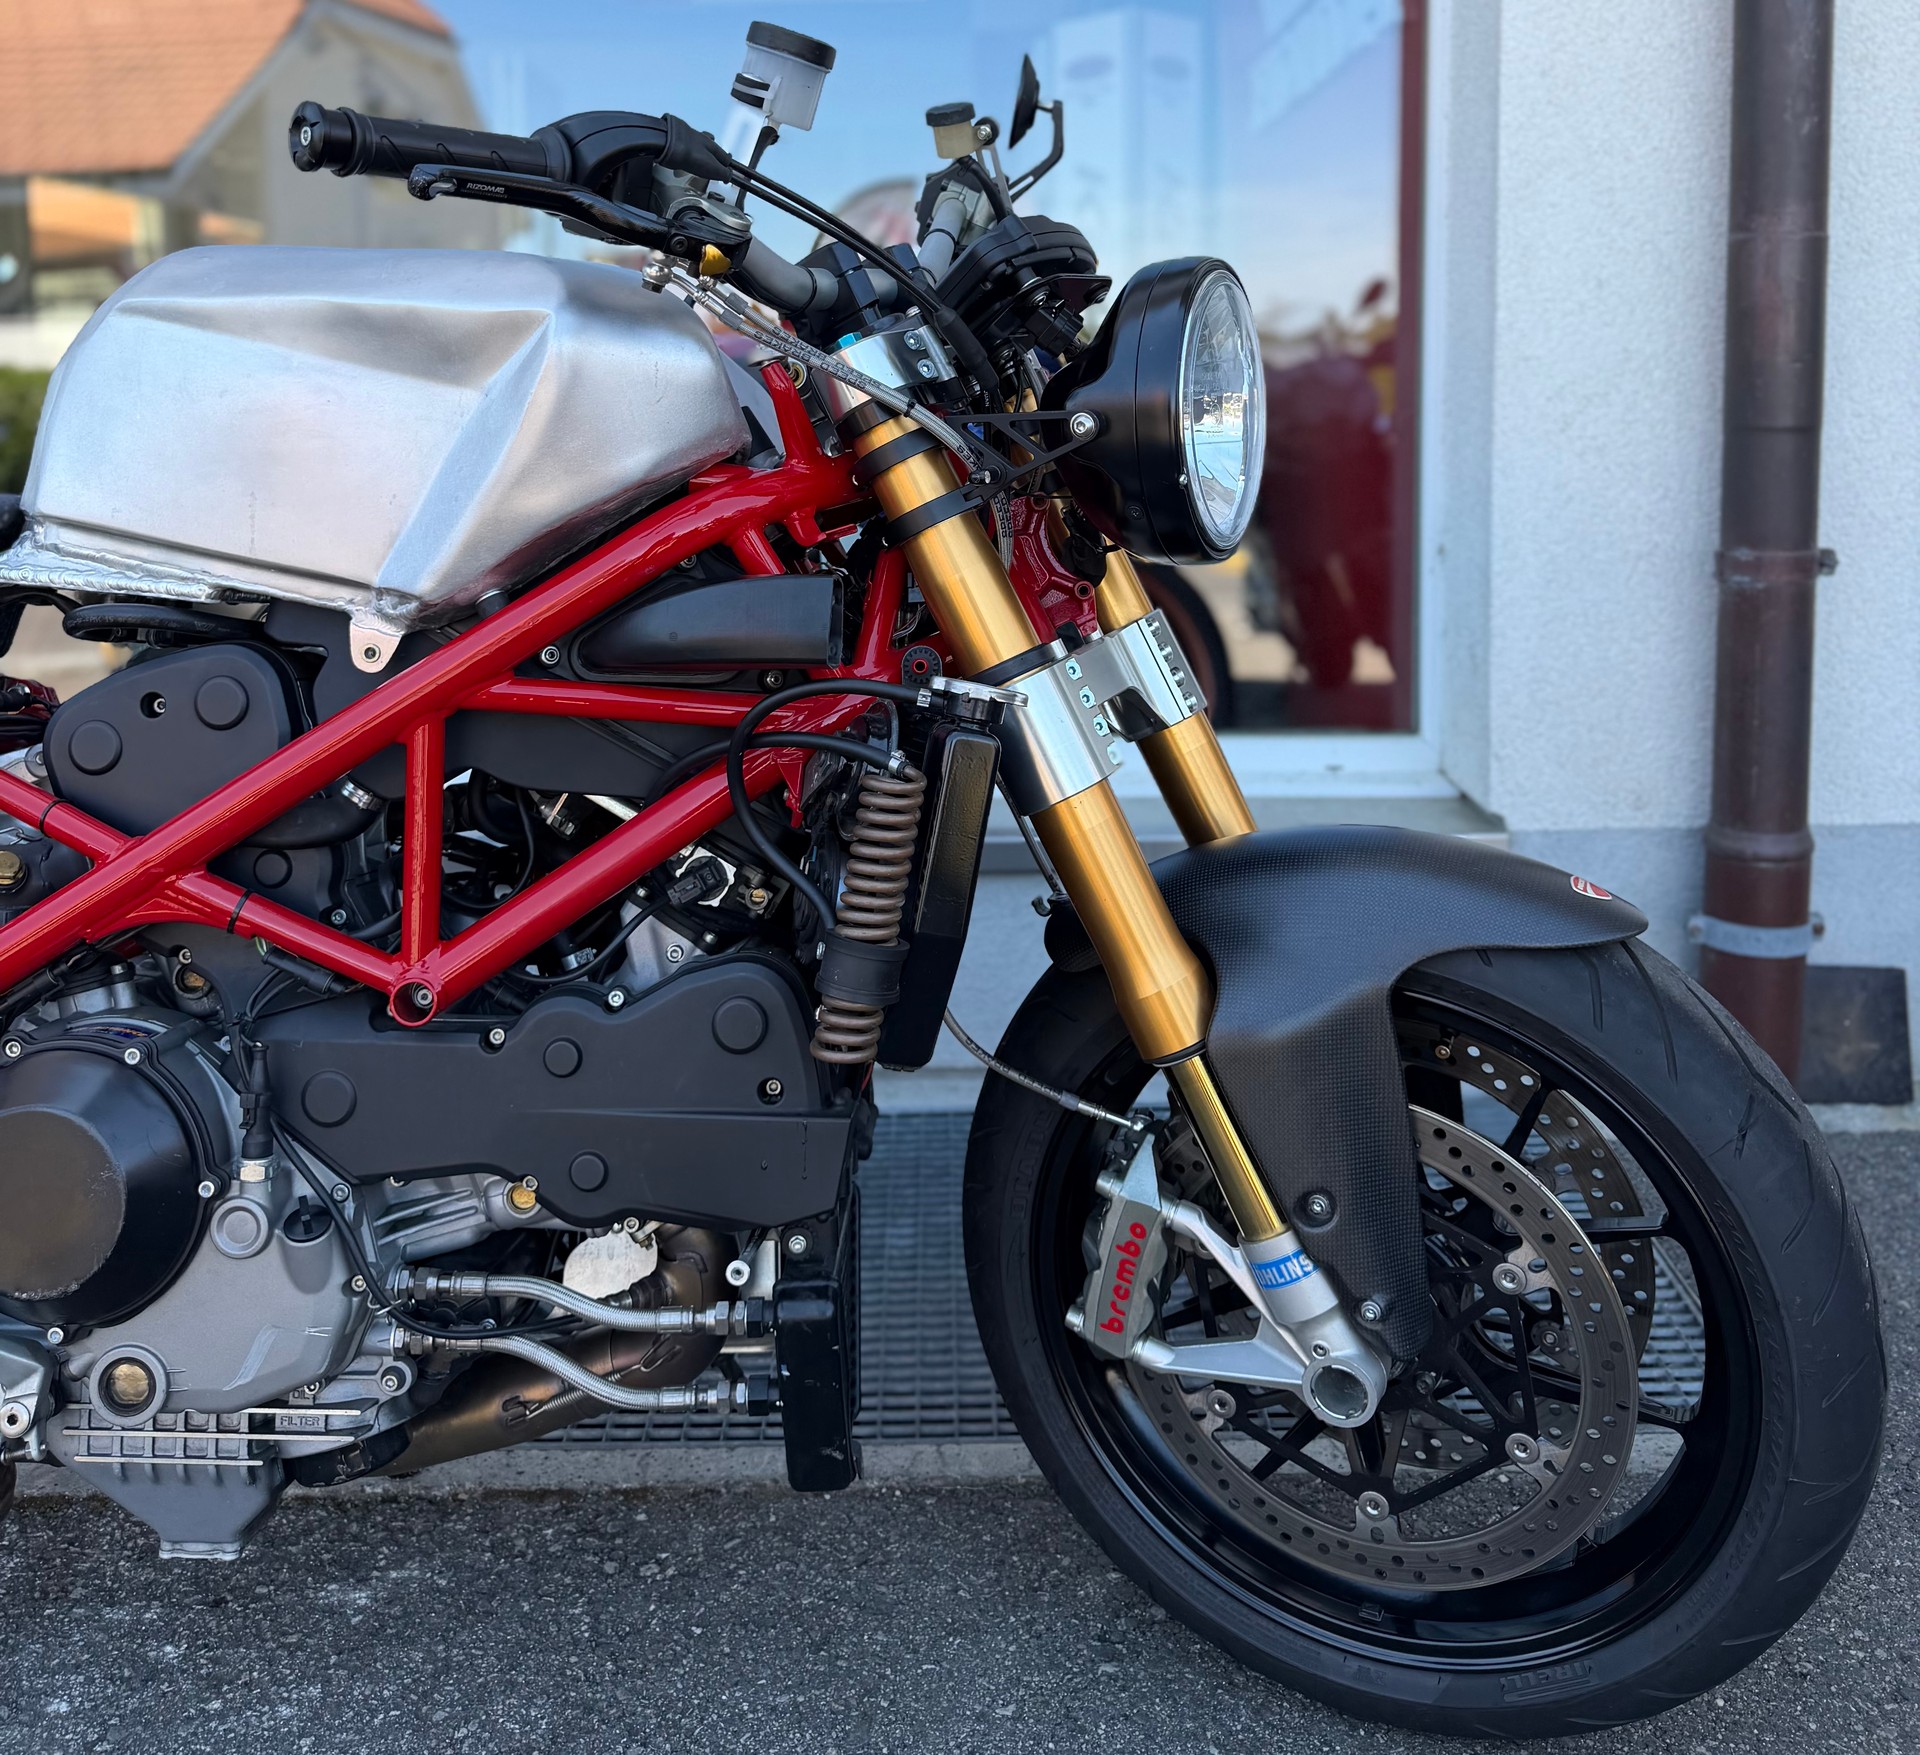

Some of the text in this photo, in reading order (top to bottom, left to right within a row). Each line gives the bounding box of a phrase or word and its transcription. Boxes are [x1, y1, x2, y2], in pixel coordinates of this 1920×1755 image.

[754, 330, 868, 389] SPEED BRAKES
[1099, 1222, 1147, 1334] brembo
[280, 1415, 320, 1426] FILTER
